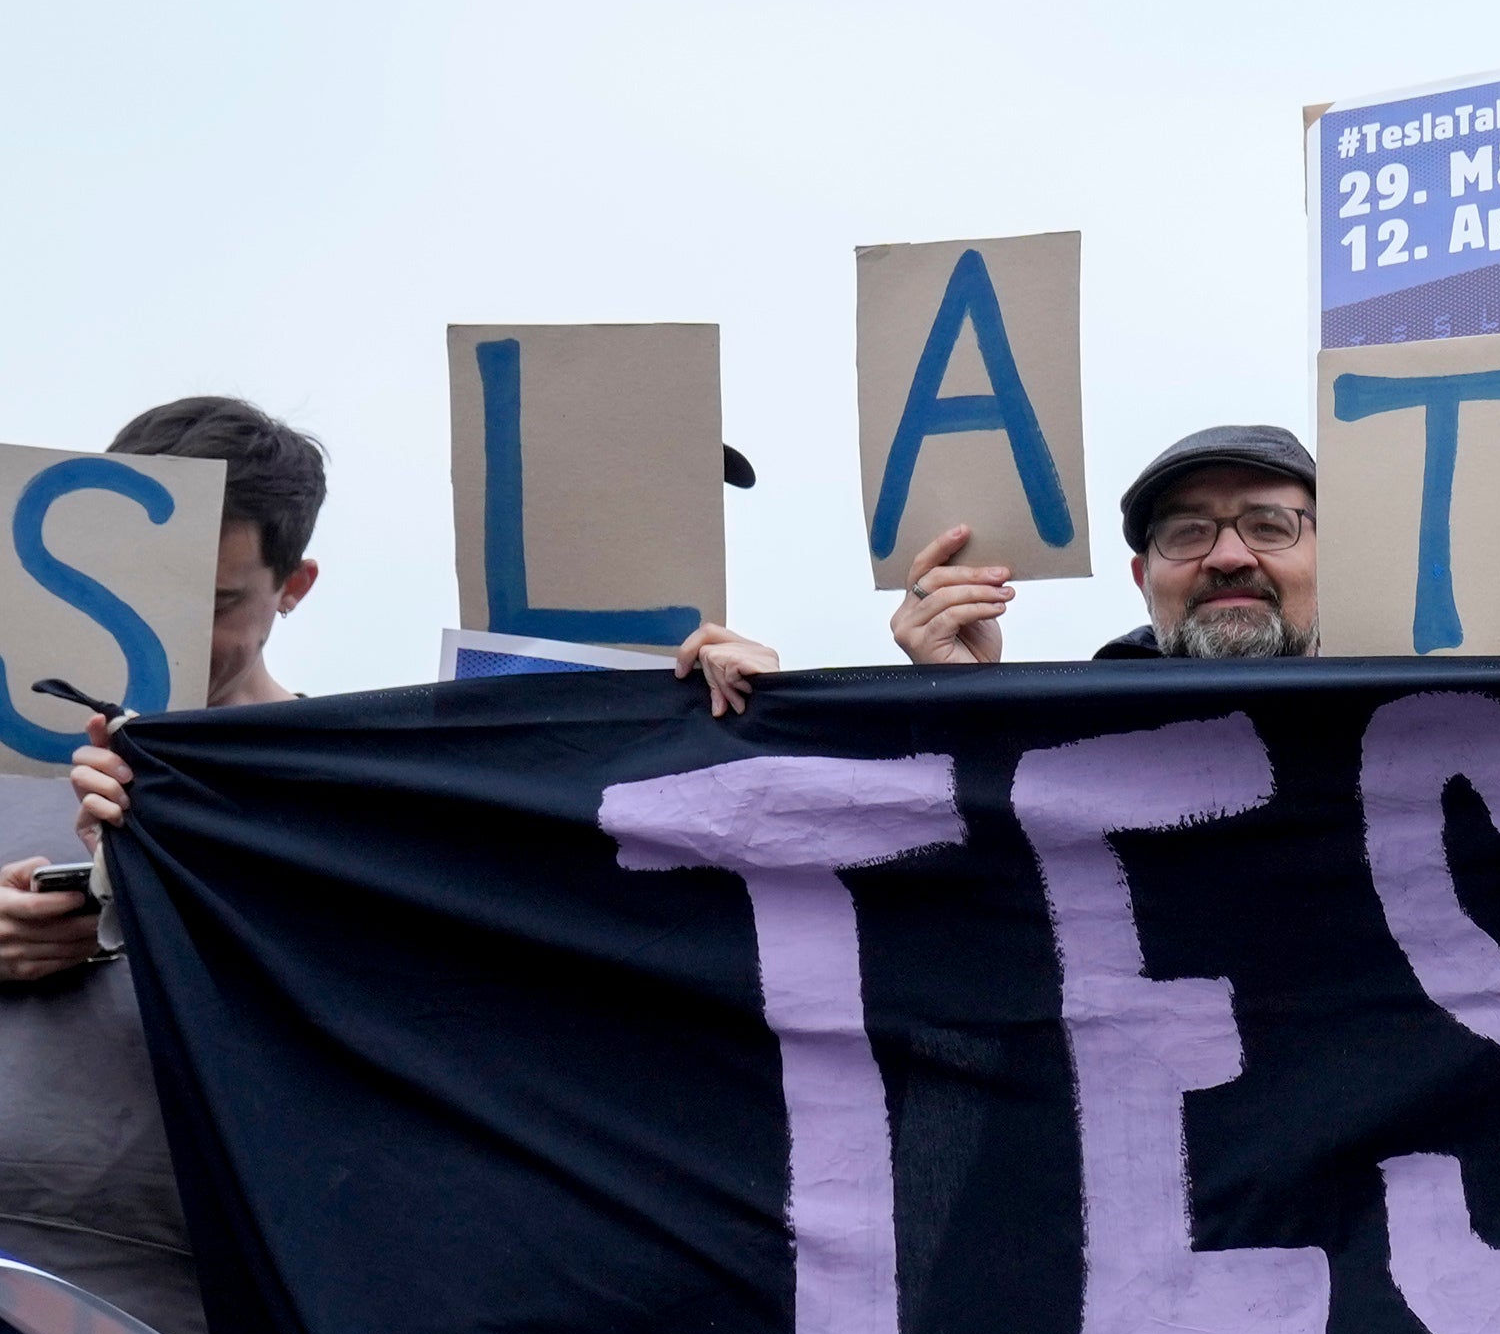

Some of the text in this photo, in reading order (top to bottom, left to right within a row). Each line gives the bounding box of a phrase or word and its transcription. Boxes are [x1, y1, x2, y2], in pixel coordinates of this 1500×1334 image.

[1339, 162, 1425, 220] 29.
[1341, 224, 1426, 273] 12.
[476, 339, 702, 645] L
[870, 249, 1075, 560] A
[0, 458, 175, 763] S
